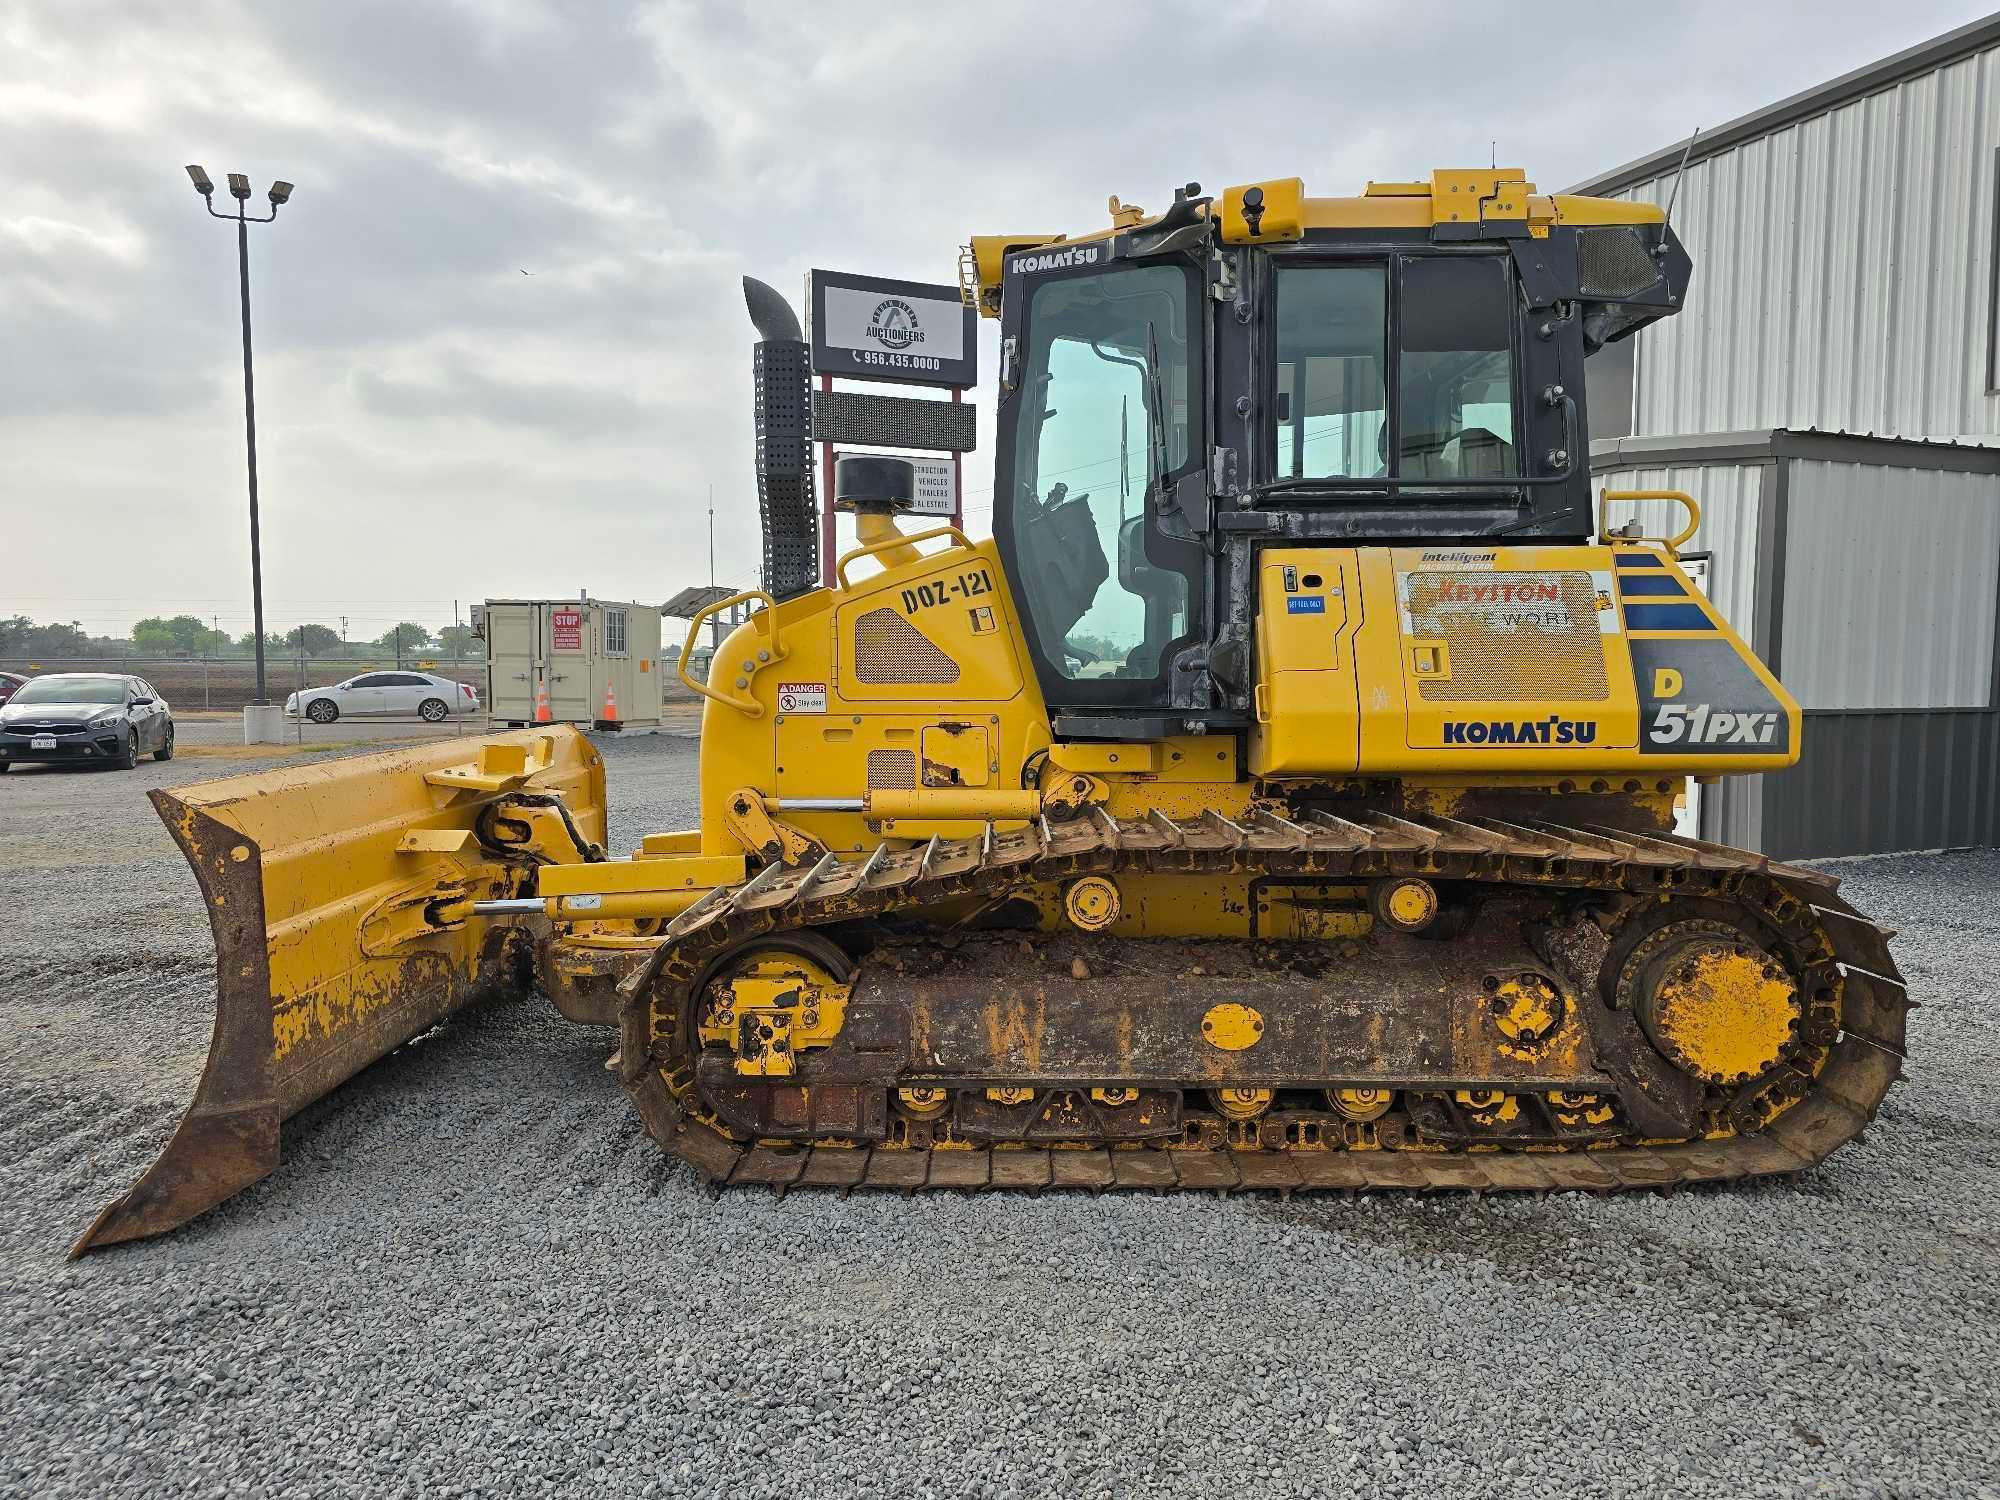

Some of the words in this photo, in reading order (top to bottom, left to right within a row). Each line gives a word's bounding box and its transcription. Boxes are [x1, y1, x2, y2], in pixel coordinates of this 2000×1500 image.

[1012, 247, 1098, 273] KOMATSU
[866, 326, 925, 342] AUCTIONEERS
[864, 351, 940, 370] 956.435.0000
[919, 478, 948, 486] VEHICLES
[919, 489, 948, 497] TRAILERS
[1422, 552, 1497, 564] intelligent
[901, 569, 993, 614] DOZ-121
[555, 615, 578, 625] STOP
[789, 684, 826, 692] DANGER
[1654, 668, 1683, 698] D
[797, 699, 810, 707] Stay
[1444, 715, 1597, 744] KOMATSU
